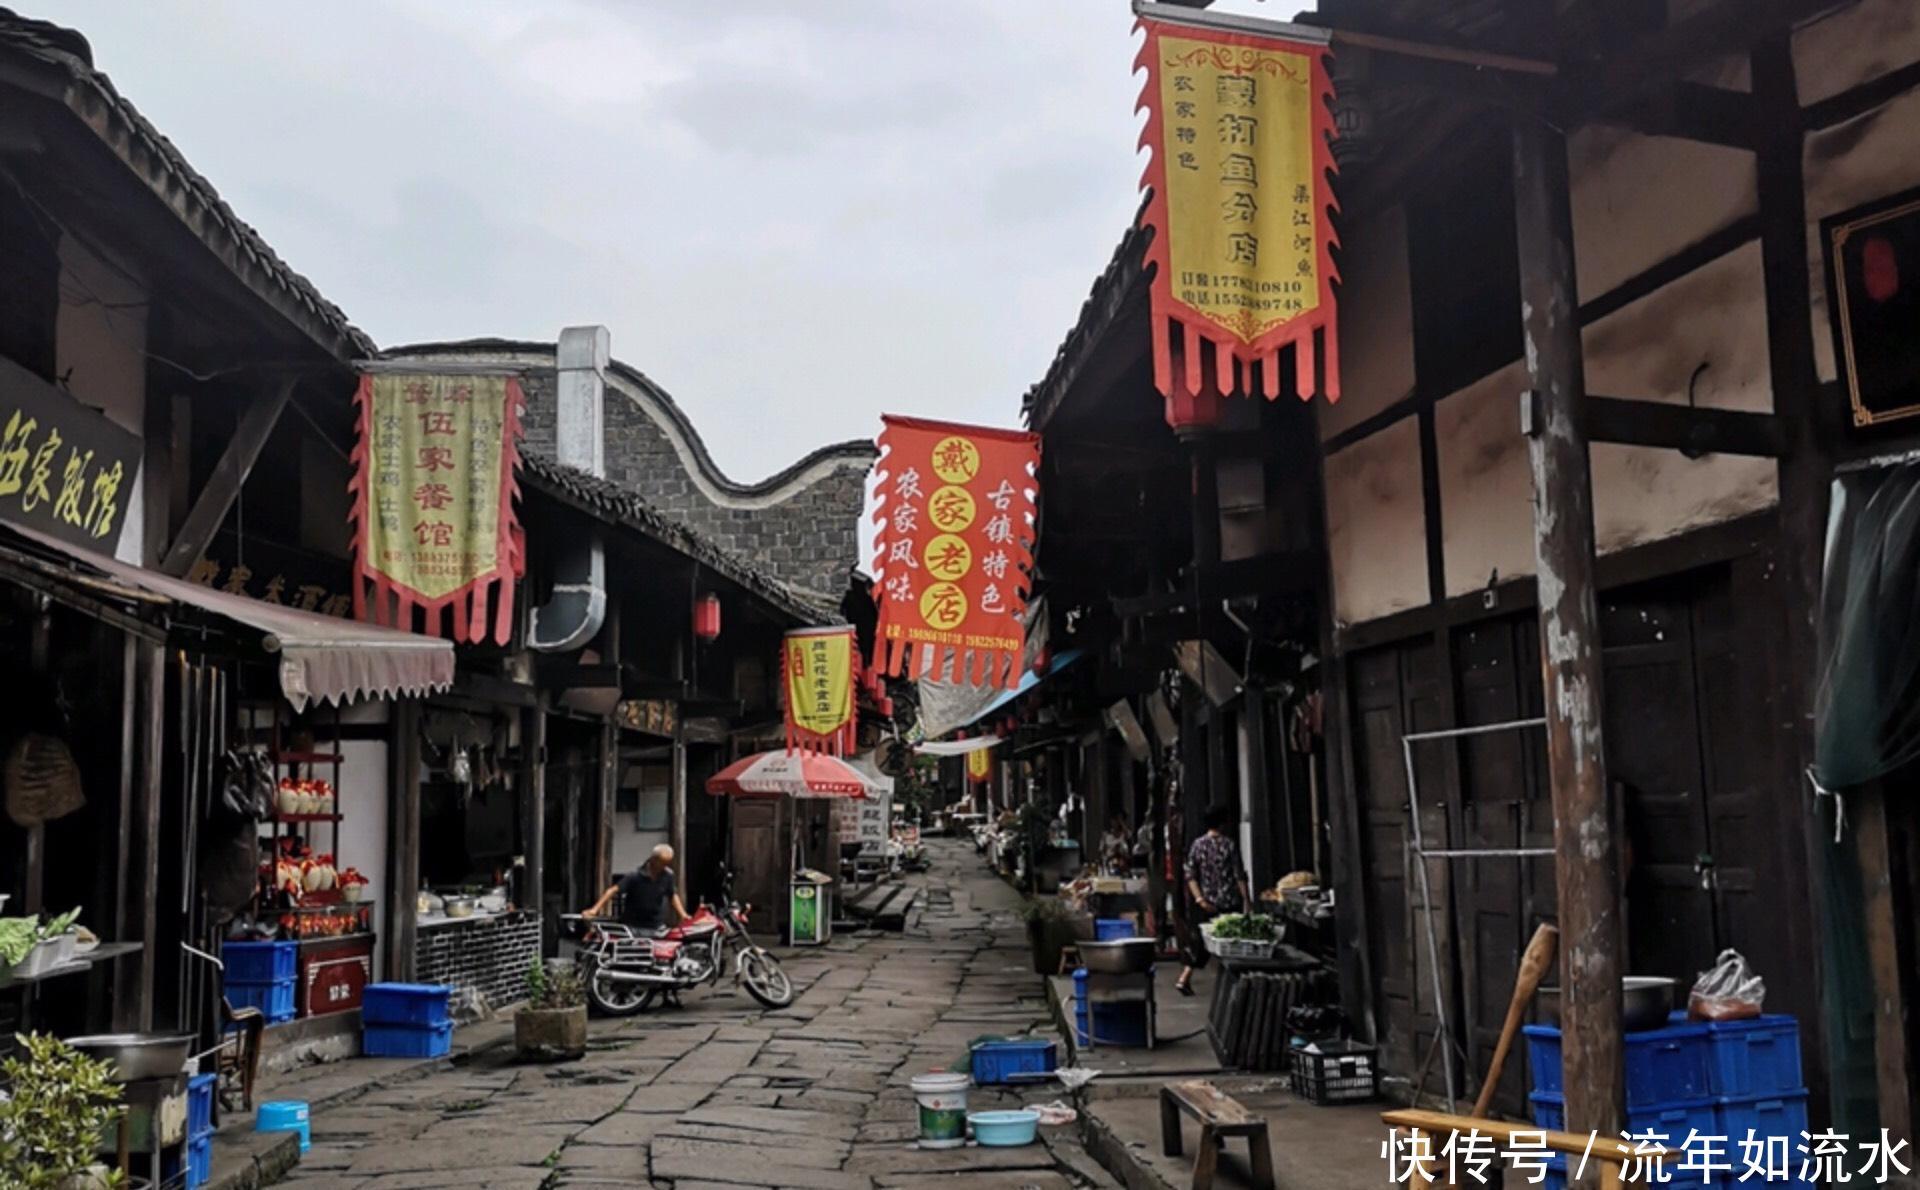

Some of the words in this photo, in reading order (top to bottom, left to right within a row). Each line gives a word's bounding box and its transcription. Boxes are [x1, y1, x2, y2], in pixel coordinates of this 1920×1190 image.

[1173, 75, 1199, 171] 农家特色
[413, 411, 457, 547] 伍家餐馆
[886, 467, 923, 602] 农家风味
[924, 439, 975, 625] 戴家老店
[981, 479, 1016, 614] 古镇特色
